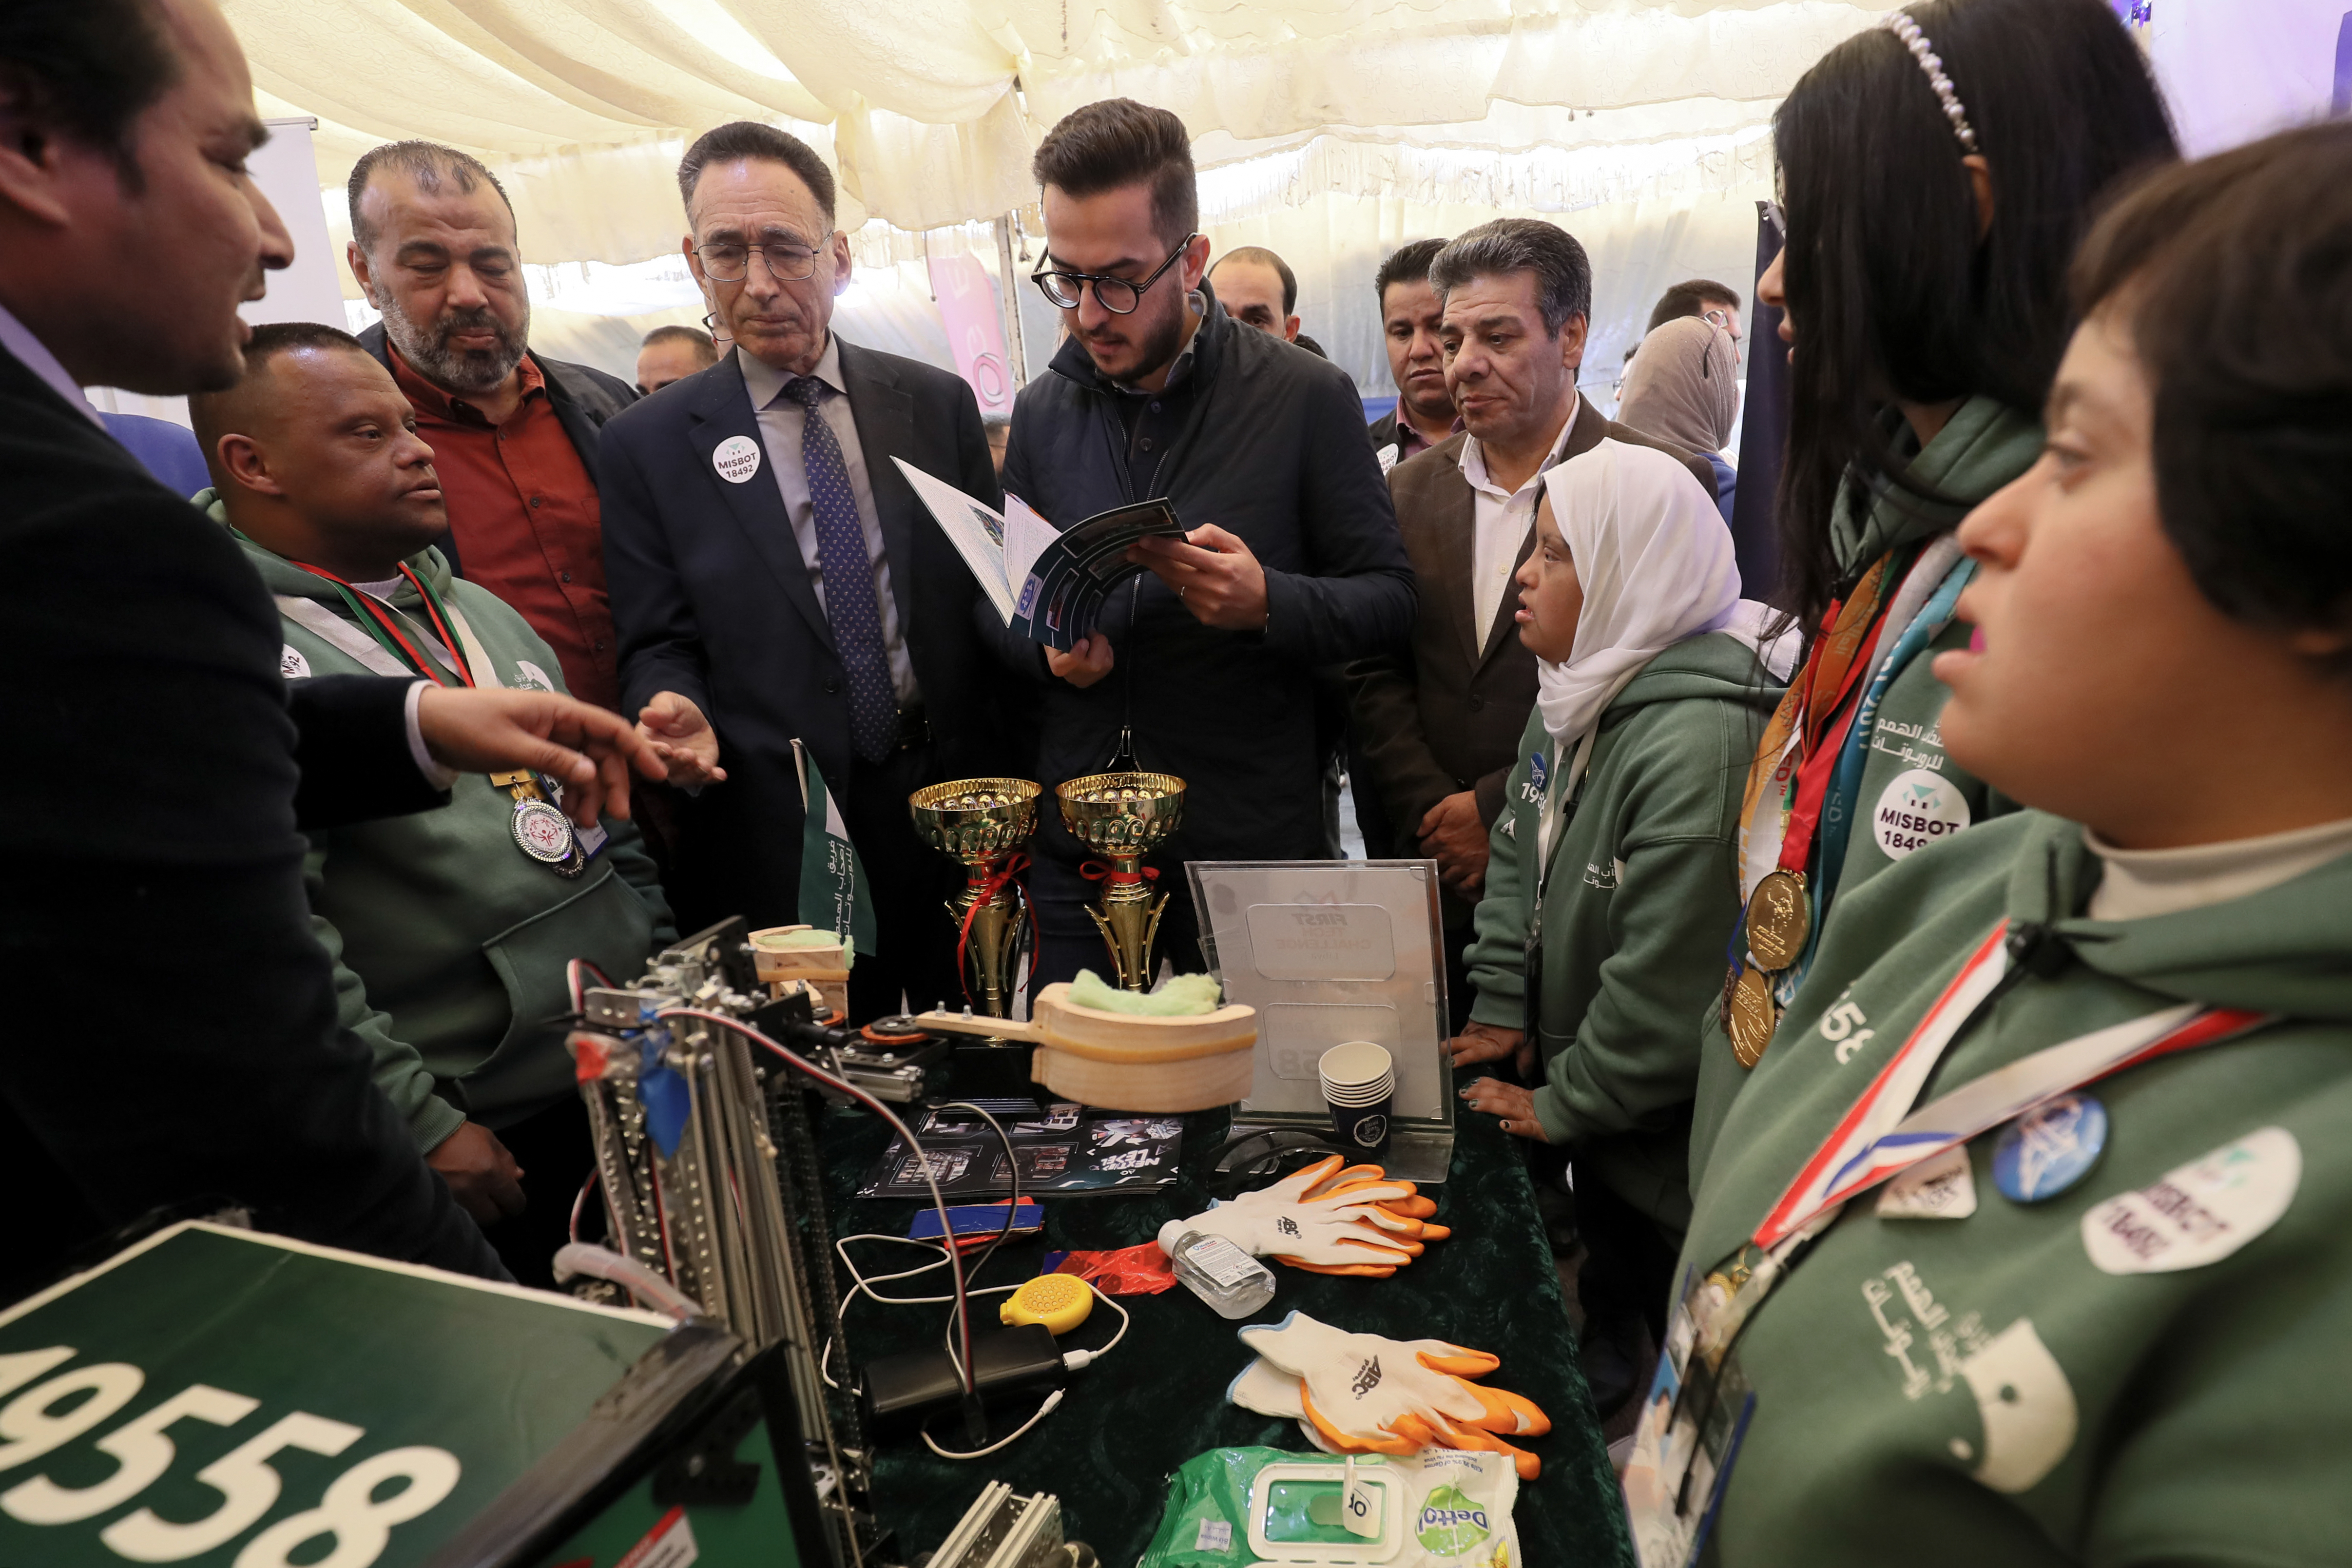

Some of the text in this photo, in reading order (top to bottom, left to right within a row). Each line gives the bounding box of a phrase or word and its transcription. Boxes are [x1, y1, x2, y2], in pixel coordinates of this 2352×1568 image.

[717, 452, 756, 469] MISBOT
[1381, 452, 1397, 466] SBOT
[726, 465, 753, 478] 18492
[1877, 717, 1923, 739] الهمم
[1871, 736, 1944, 770] للروبوتات
[1880, 807, 1960, 835] MISBOT
[1885, 830, 1929, 851] 1849
[828, 840, 837, 873] فريق
[837, 842, 846, 890] أصحاب
[1468, 1463, 1483, 1473] Kills
[1419, 1507, 1489, 1532] Dettol
